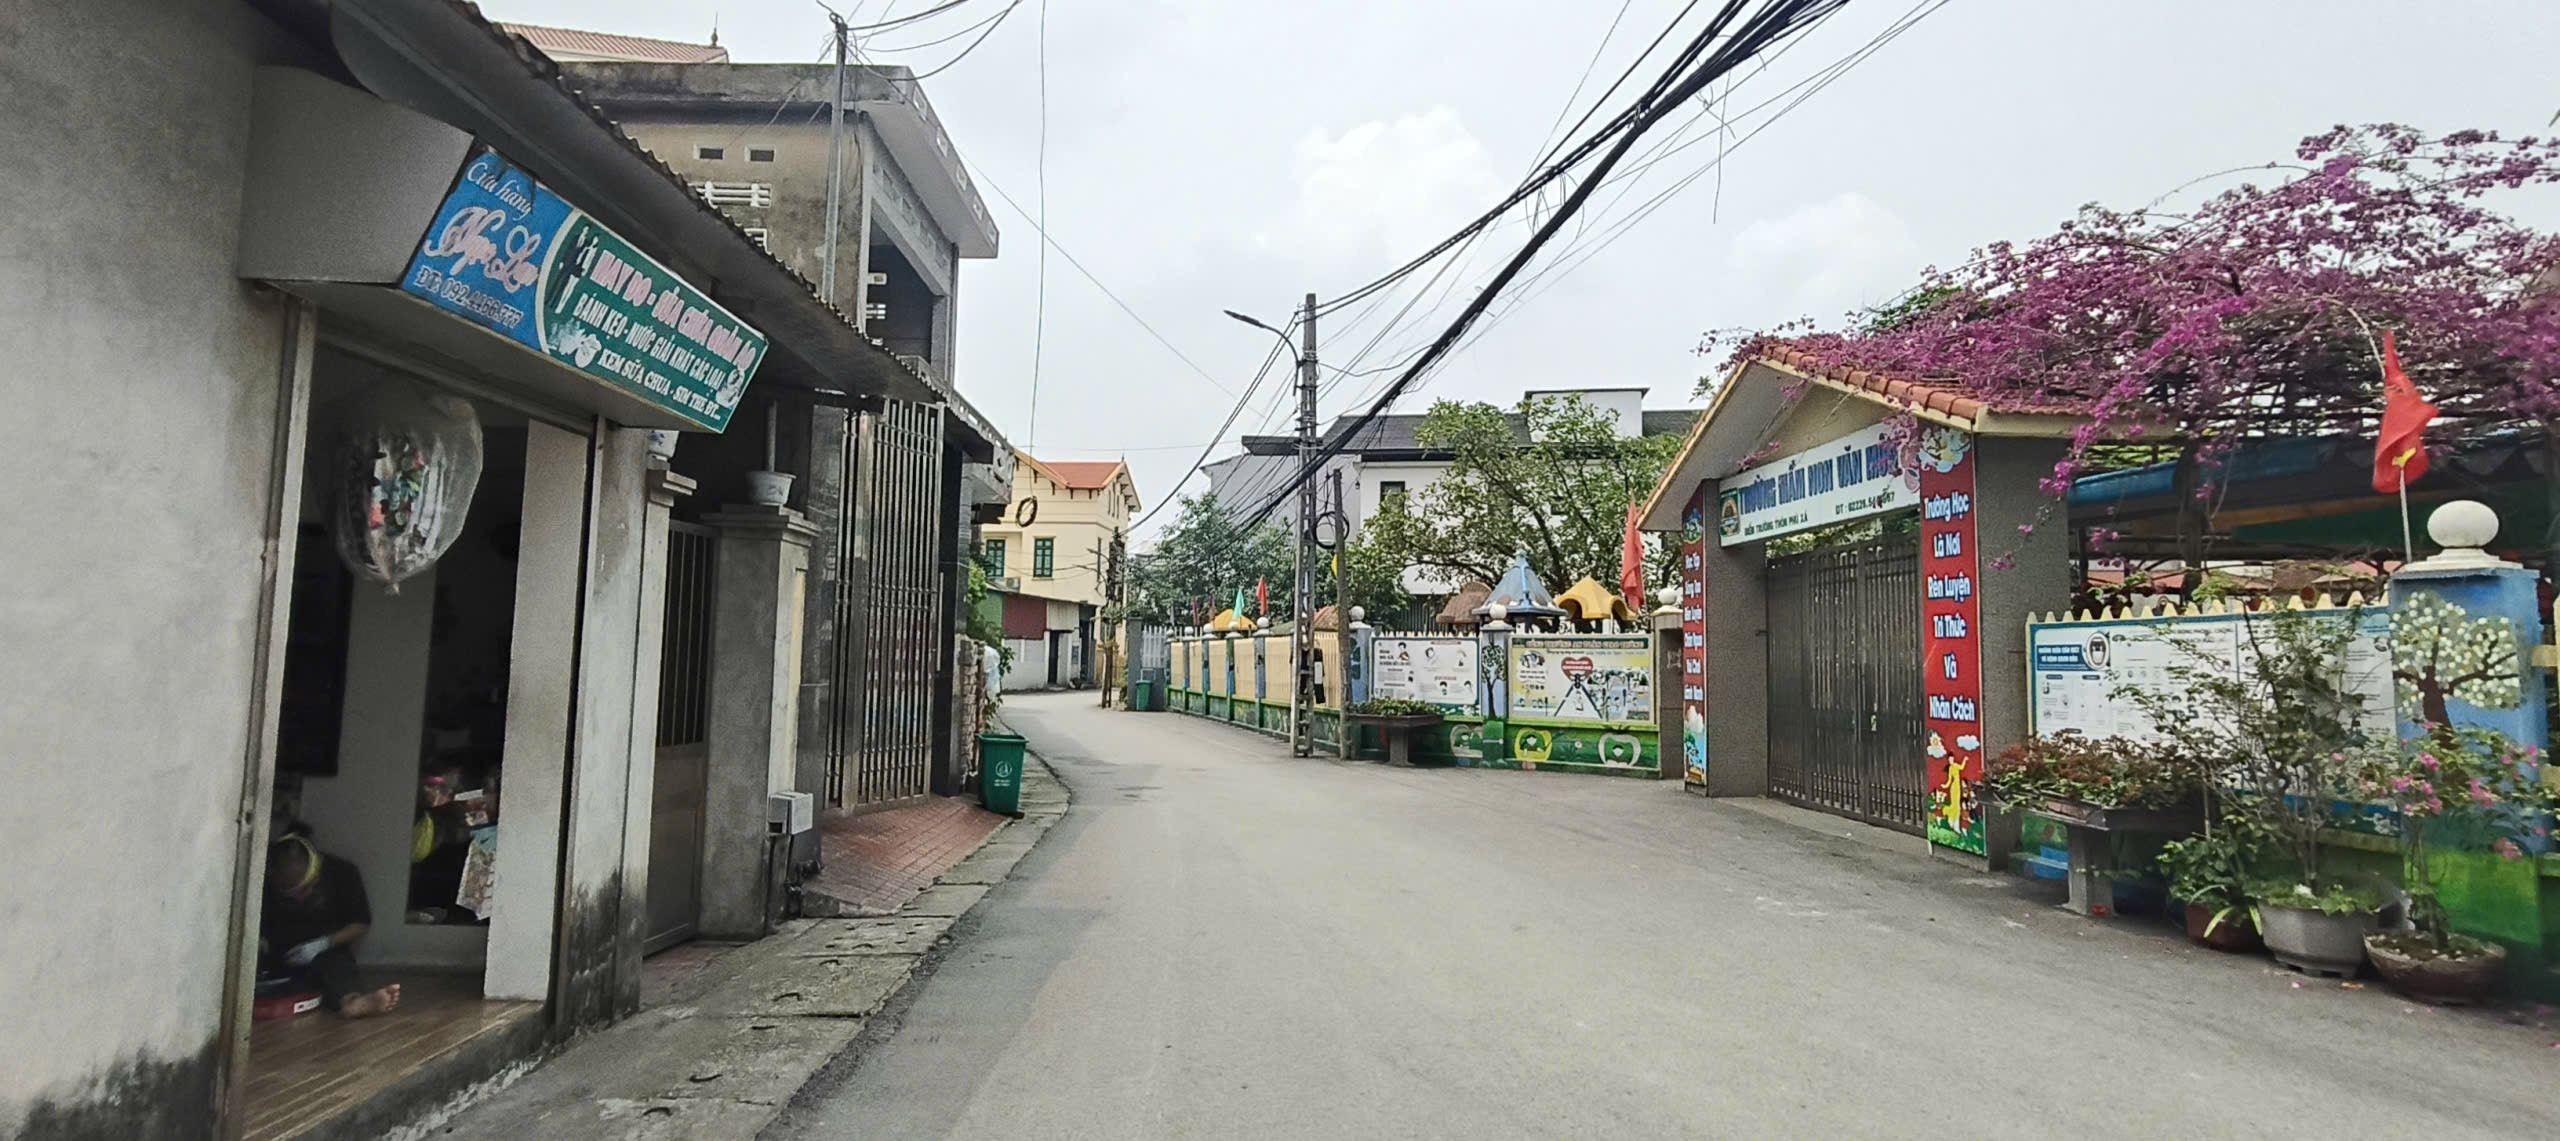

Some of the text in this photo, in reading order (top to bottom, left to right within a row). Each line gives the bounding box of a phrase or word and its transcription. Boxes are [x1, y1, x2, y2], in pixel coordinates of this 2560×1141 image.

[590, 250, 635, 295] MAY
[733, 340, 757, 371] ÁO
[573, 293, 609, 328] BÁNH
[601, 308, 628, 340] KẸO
[625, 322, 656, 352] NƯỚC
[650, 335, 676, 366] GIẢI
[668, 347, 696, 374] KHÁT
[689, 357, 708, 384] CÁC
[704, 367, 727, 394] LOẠI
[598, 349, 624, 373] KEM
[621, 359, 645, 384] SỮA
[644, 371, 672, 397] CHUA
[672, 385, 693, 405] SIM
[1808, 458, 1833, 496] NON
[1837, 445, 1862, 488] VĂN
[1924, 491, 1970, 522] Trường Học
[1933, 532, 1961, 558] Là Nơi
[1927, 571, 1971, 602] Rèn Luyện
[1944, 612, 1966, 638] Thức
[1943, 653, 1957, 679] Và
[1929, 694, 1975, 721] Nhân Cách
